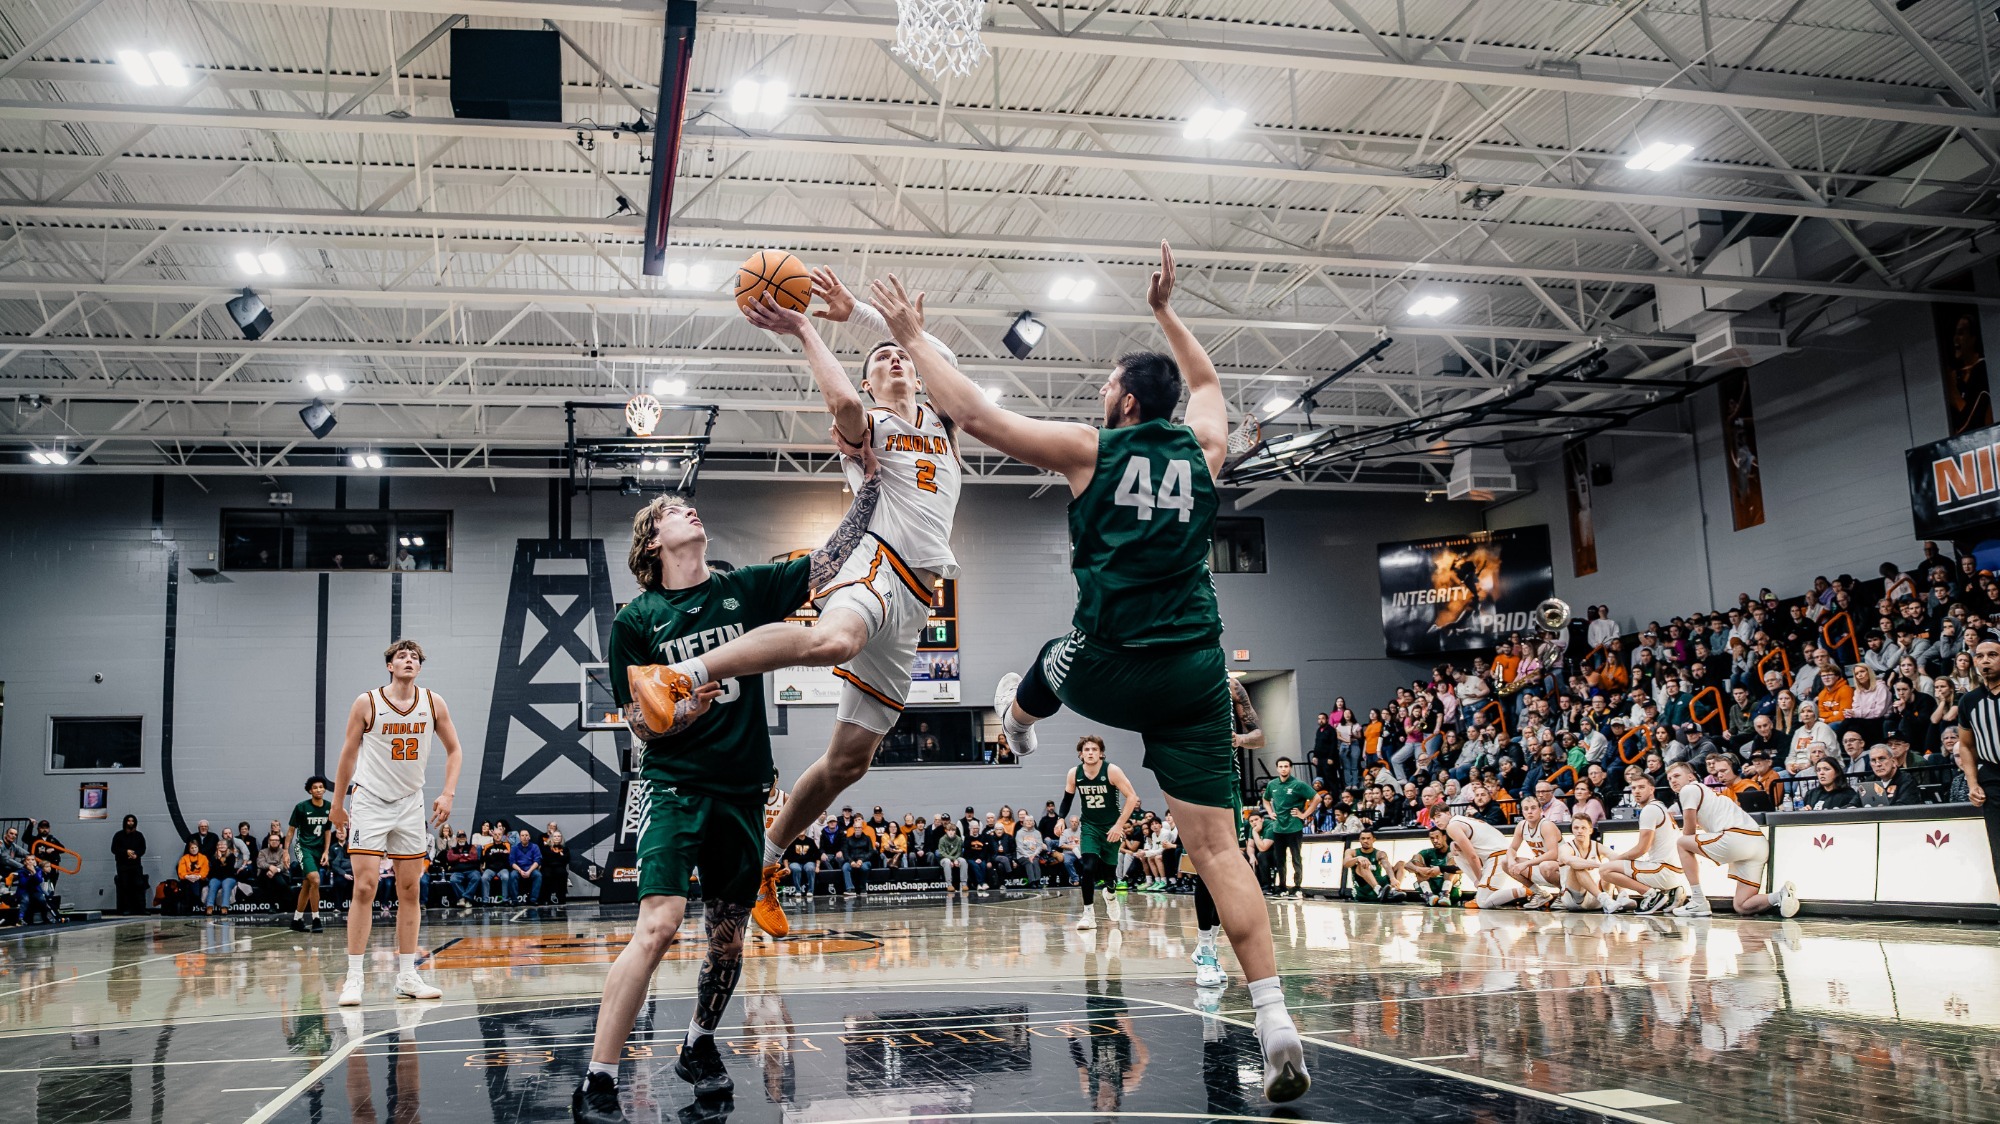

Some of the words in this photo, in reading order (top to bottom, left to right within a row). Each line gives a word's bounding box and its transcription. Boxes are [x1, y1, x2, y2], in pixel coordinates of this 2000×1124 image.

[915, 459, 938, 494] 2
[1114, 455, 1194, 522] 44
[1392, 586, 1469, 608] INTEGRITY
[382, 722, 427, 735] FINDLAY
[391, 738, 419, 760] 22
[1078, 785, 1108, 795] TIFFIN
[1085, 795, 1106, 809] 22
[313, 825, 322, 837] 4
[865, 881, 948, 891] losedInASnapp.com
